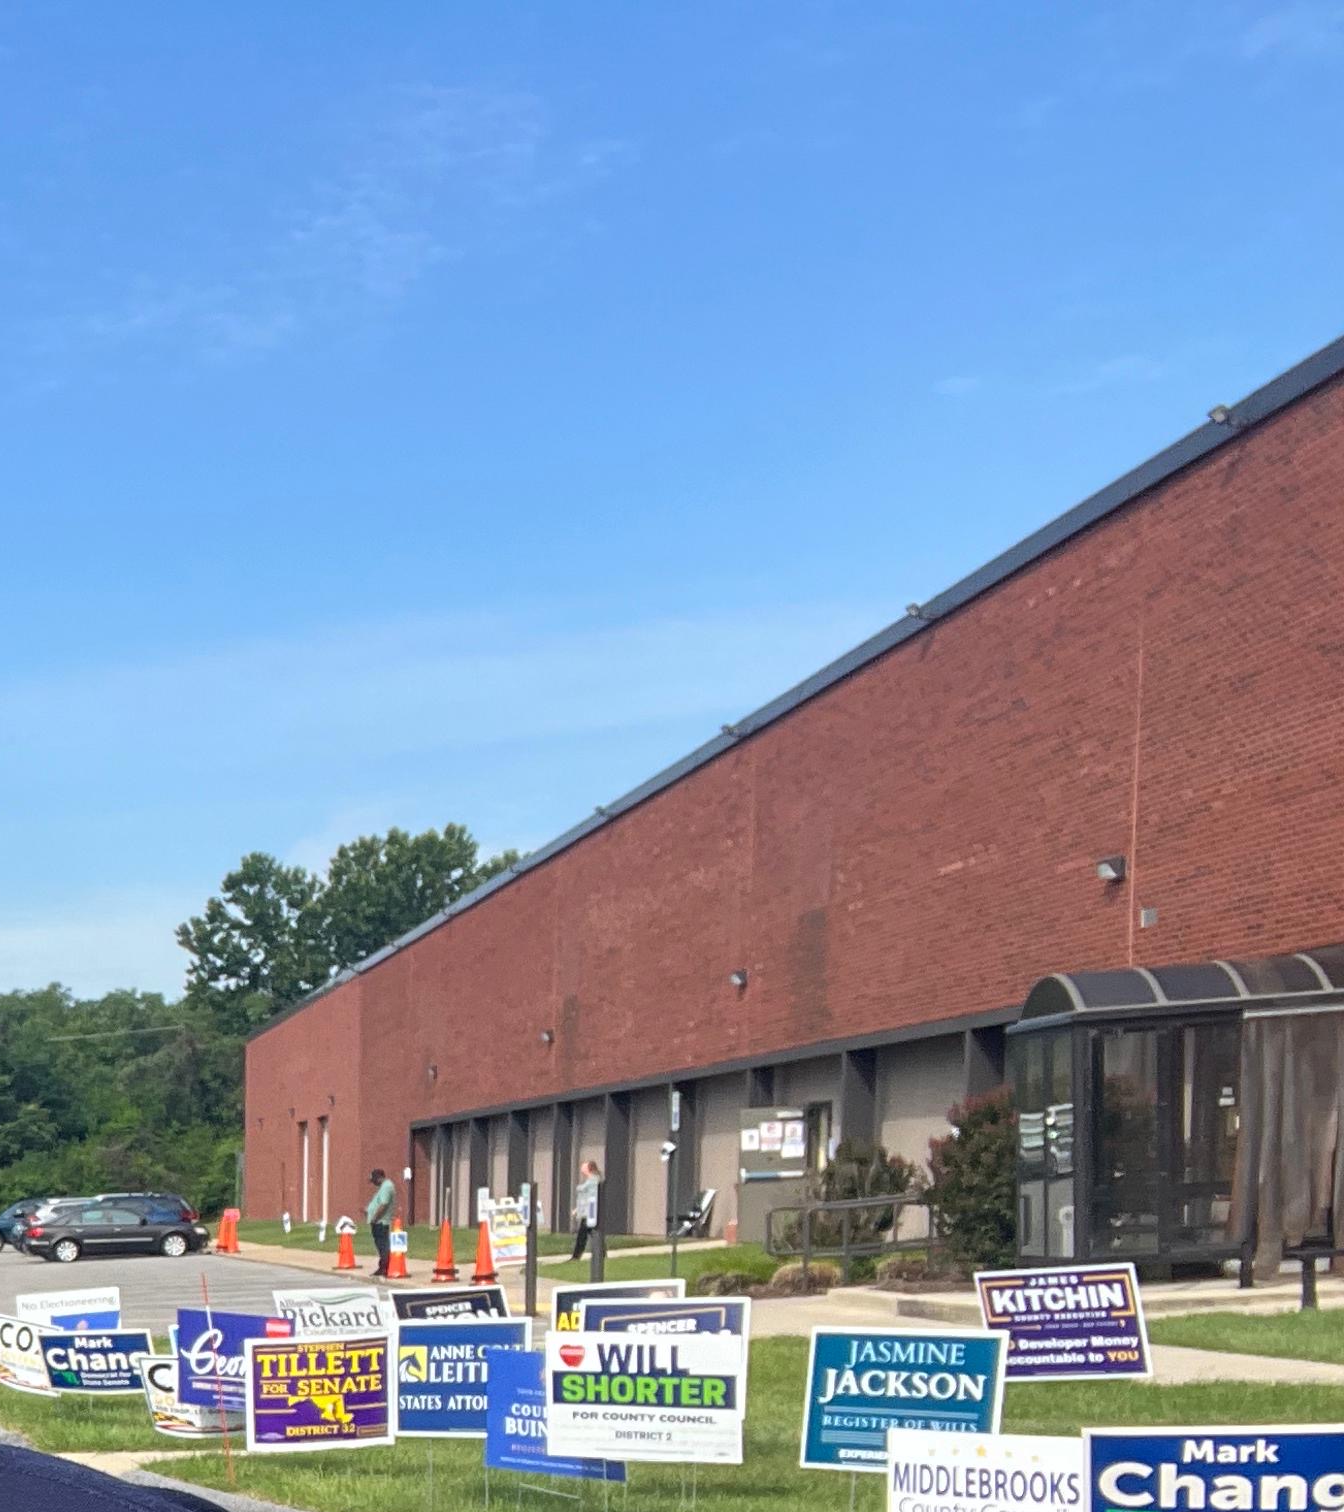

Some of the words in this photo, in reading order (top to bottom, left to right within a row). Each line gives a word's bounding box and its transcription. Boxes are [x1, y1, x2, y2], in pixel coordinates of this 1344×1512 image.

[1029, 1275, 1079, 1287] JAMES
[991, 1283, 1125, 1314] KITCHIN
[280, 1305, 384, 1328] Pickard
[74, 1337, 114, 1349] Mark
[430, 1345, 475, 1360] ANNE
[1018, 1337, 1088, 1351] Developer
[1090, 1335, 1139, 1349] Money
[256, 1348, 385, 1377] TILLETT
[597, 1343, 690, 1374] WILL
[844, 1340, 966, 1368] JASMINE
[1006, 1352, 1086, 1366] ccountable
[1089, 1351, 1105, 1363] to
[1107, 1350, 1140, 1362] YOU
[262, 1384, 288, 1394] FOR
[297, 1374, 382, 1396] SENATE
[561, 1374, 727, 1406] SHORTER
[817, 1368, 987, 1403] JACKSON
[399, 1395, 442, 1411] STATES
[572, 1411, 599, 1421] FOR
[602, 1411, 655, 1423] COUNTY
[658, 1414, 717, 1425] COUNCIL
[822, 1414, 899, 1430] REGISTER
[904, 1419, 923, 1431] OF
[928, 1420, 978, 1433] WILLS
[285, 1424, 340, 1437] DISTRICT
[615, 1430, 664, 1441] DISTRICT
[1183, 1439, 1279, 1463] Mark
[893, 1461, 1080, 1505] MIDDLEBROOKS
